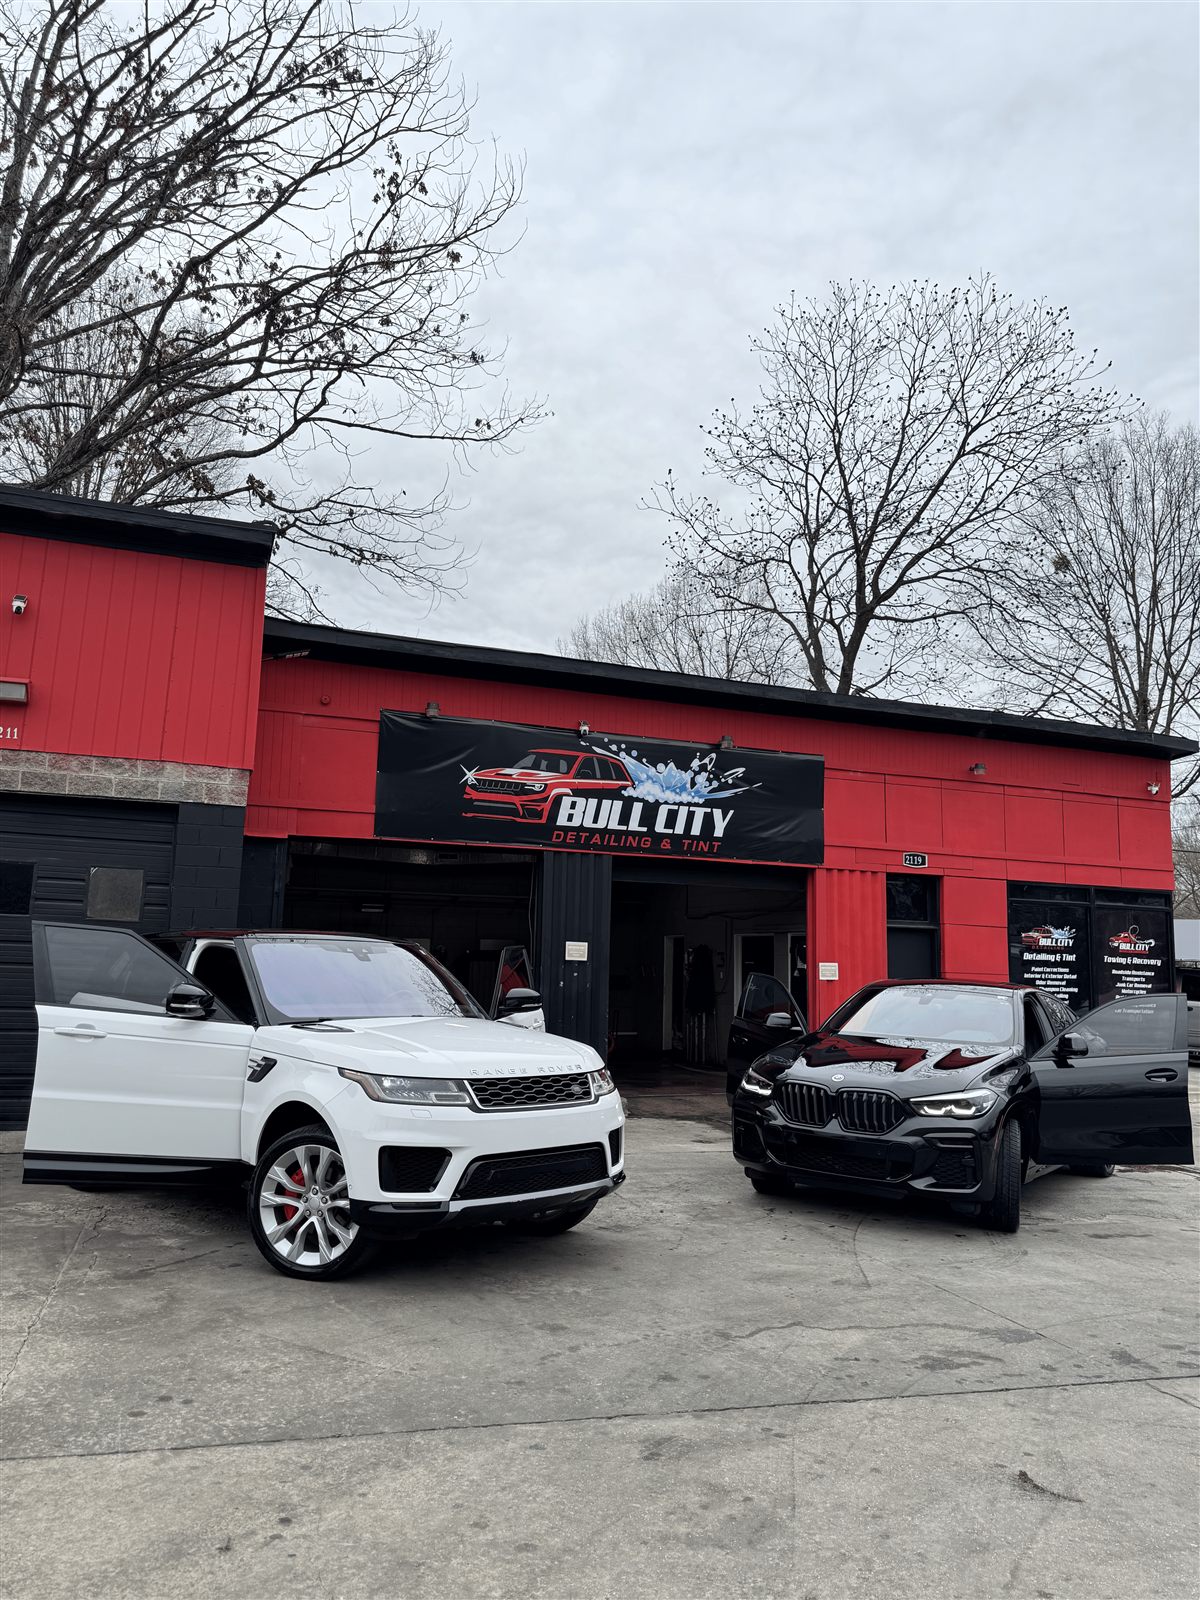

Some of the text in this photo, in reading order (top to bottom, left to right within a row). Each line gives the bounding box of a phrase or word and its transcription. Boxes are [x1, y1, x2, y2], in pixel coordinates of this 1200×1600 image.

[555, 795, 735, 838] BULL CITY
[552, 831, 722, 853] DETAILING & TINT
[905, 855, 922, 865] 2119
[1039, 938, 1075, 947] BULL CITY
[1023, 952, 1076, 962] Detailing & Tint
[1104, 955, 1162, 967] Towing & Recovery
[470, 1064, 583, 1076] RANGE ROVER
